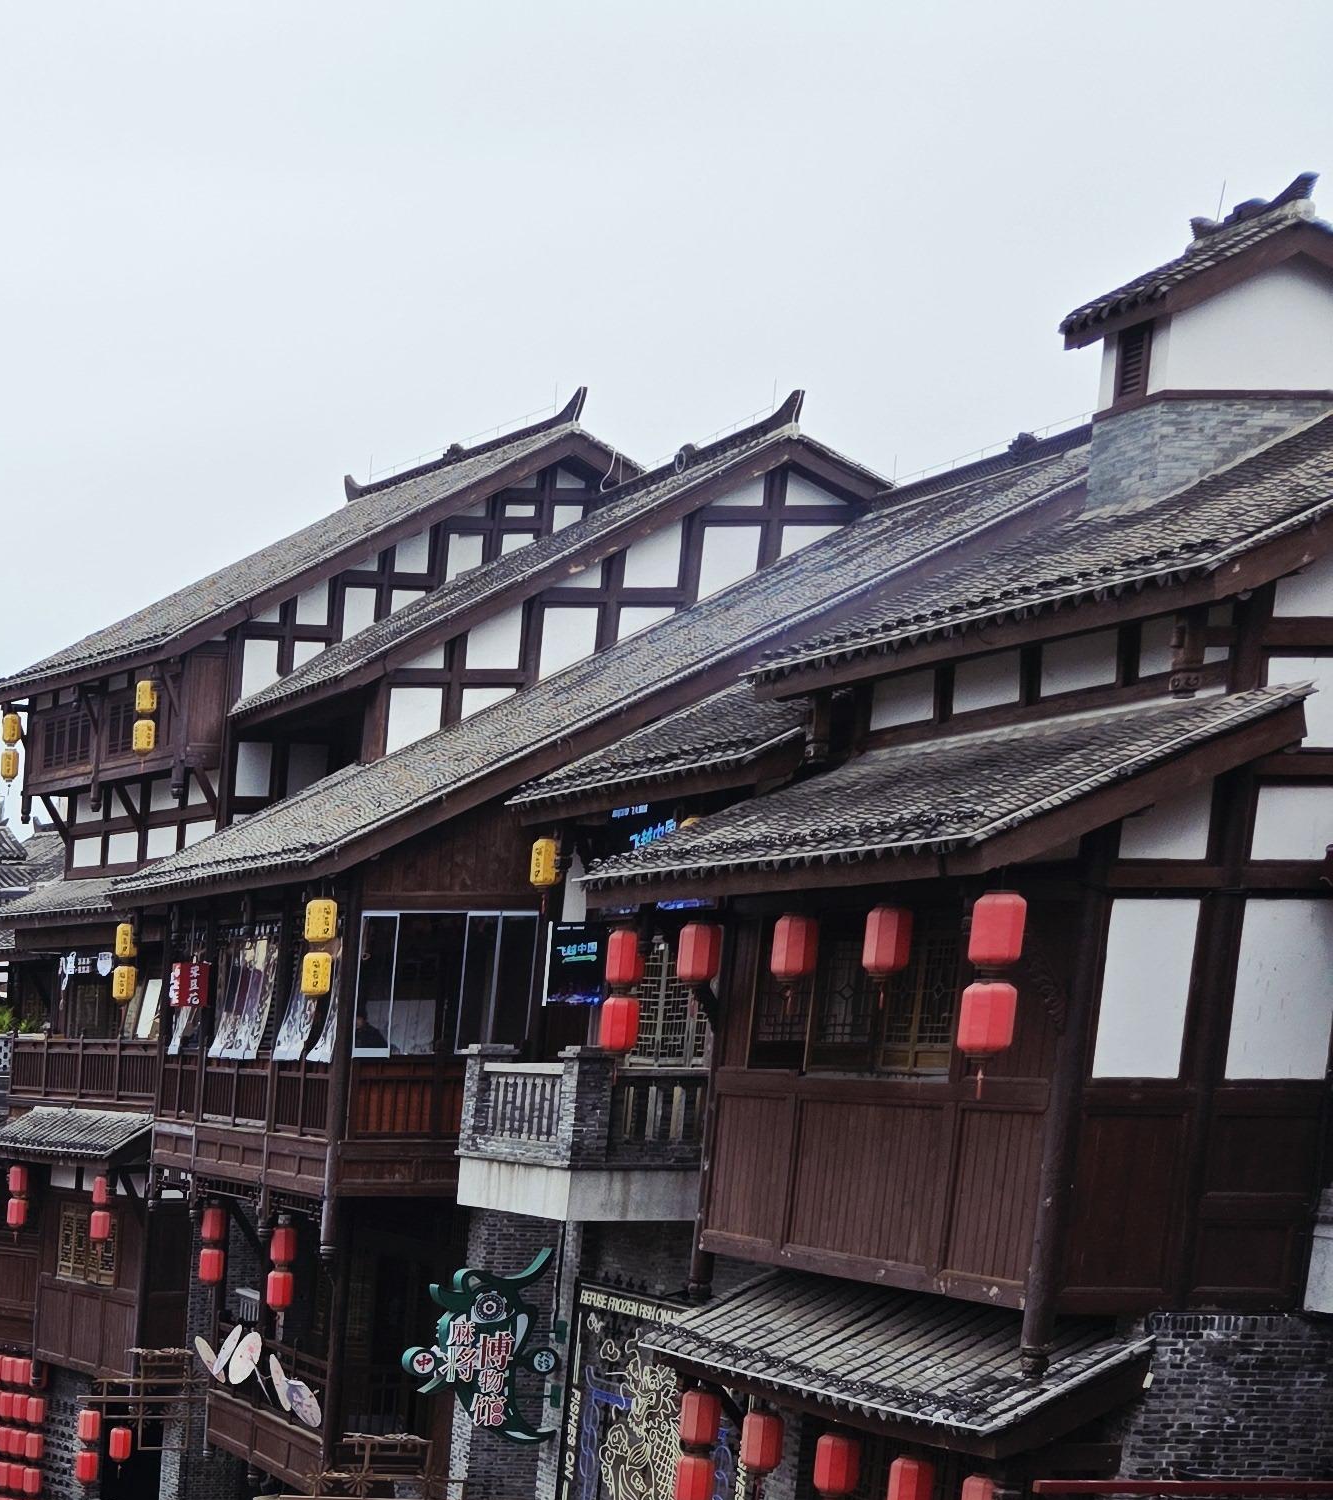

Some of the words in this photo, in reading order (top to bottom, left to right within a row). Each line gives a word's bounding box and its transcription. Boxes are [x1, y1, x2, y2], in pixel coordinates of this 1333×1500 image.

[580, 1289, 608, 1311] REFUSE
[608, 1297, 639, 1317] FROZEN
[638, 1303, 655, 1322] FISH
[469, 1330, 516, 1428] 博物馆
[566, 1389, 582, 1447] FISHES
[564, 1450, 576, 1481] ON
